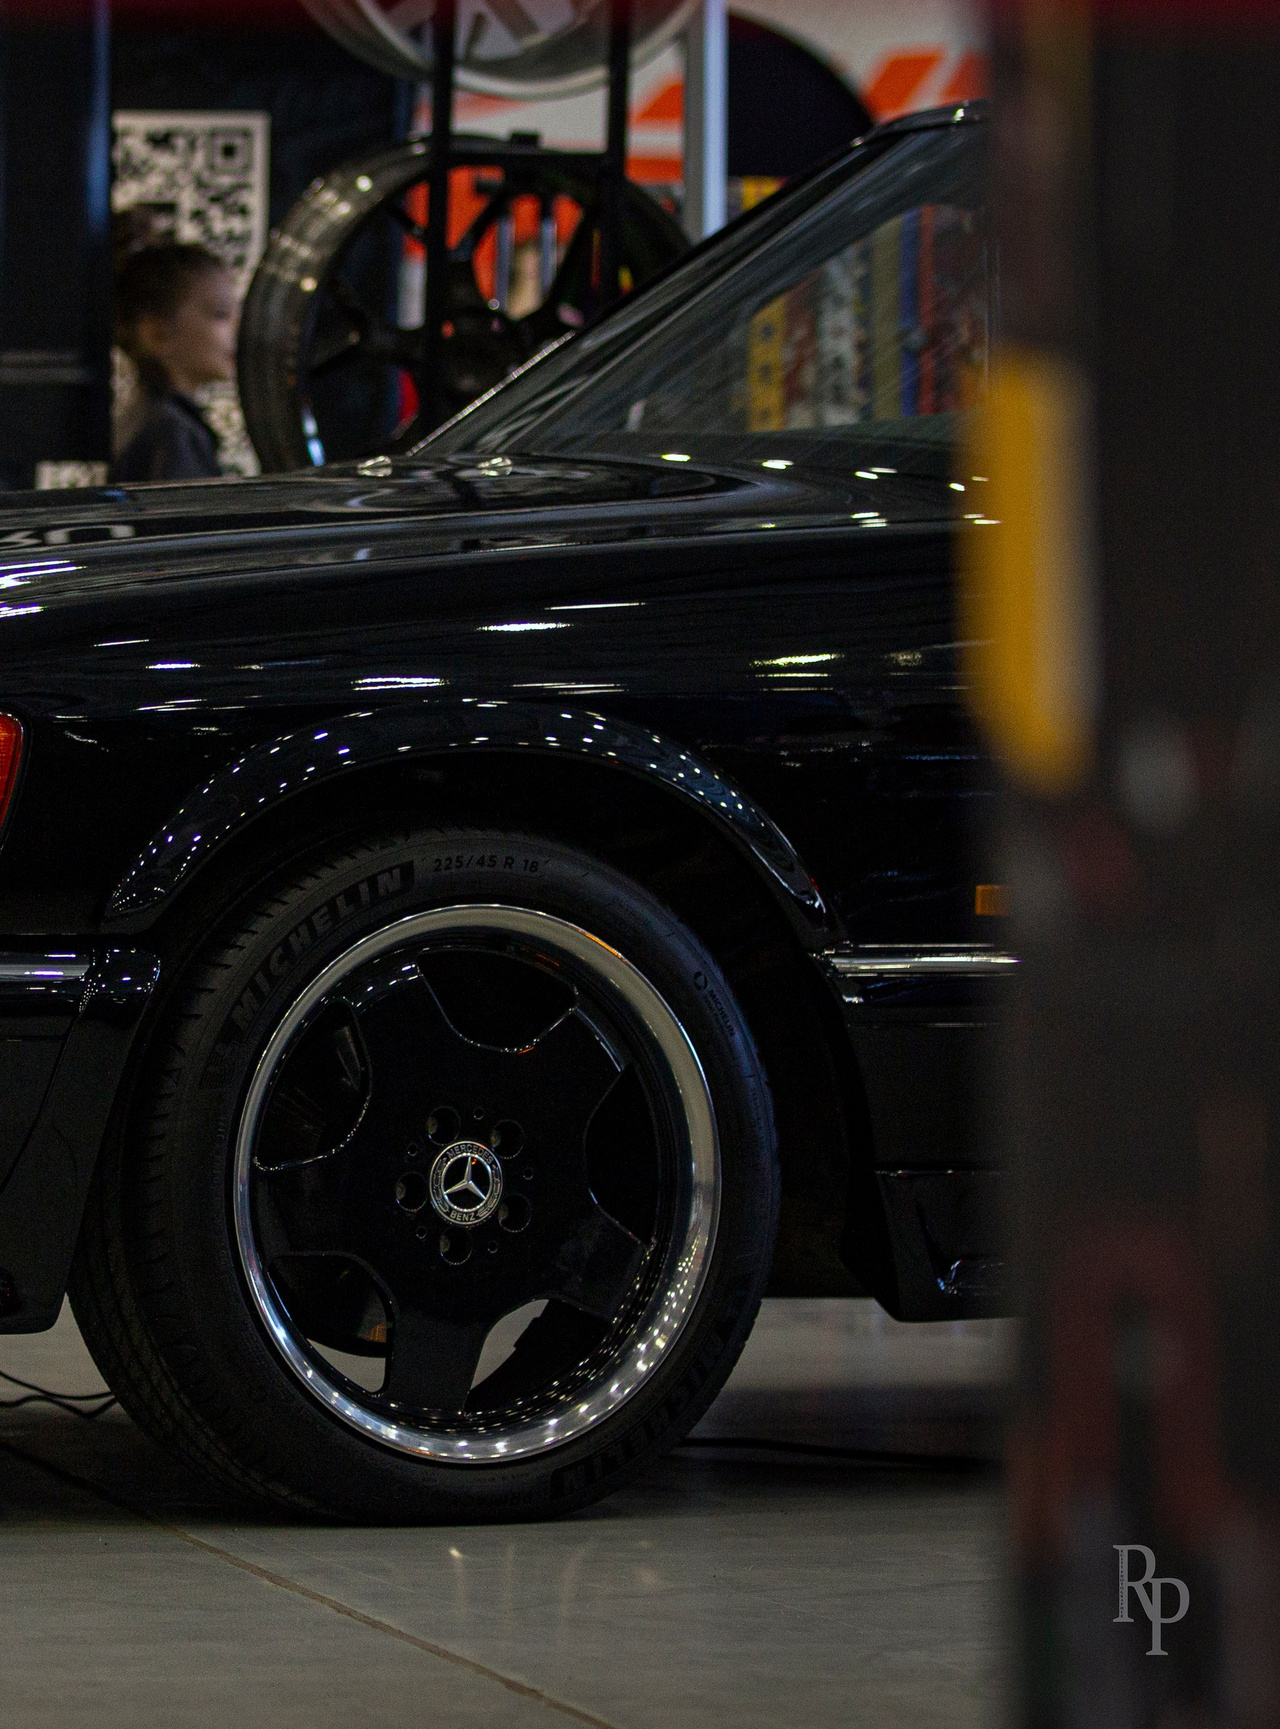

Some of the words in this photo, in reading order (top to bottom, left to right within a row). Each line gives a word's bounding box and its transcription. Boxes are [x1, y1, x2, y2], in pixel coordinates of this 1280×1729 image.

[433, 855, 496, 872] 225/45
[503, 856, 515, 869] R
[523, 859, 539, 873] 18
[232, 867, 403, 1032] MICHELIN
[707, 989, 736, 1038] MICHELIN
[446, 1144, 494, 1164] MERCEDES
[450, 1210, 476, 1221] BENZ
